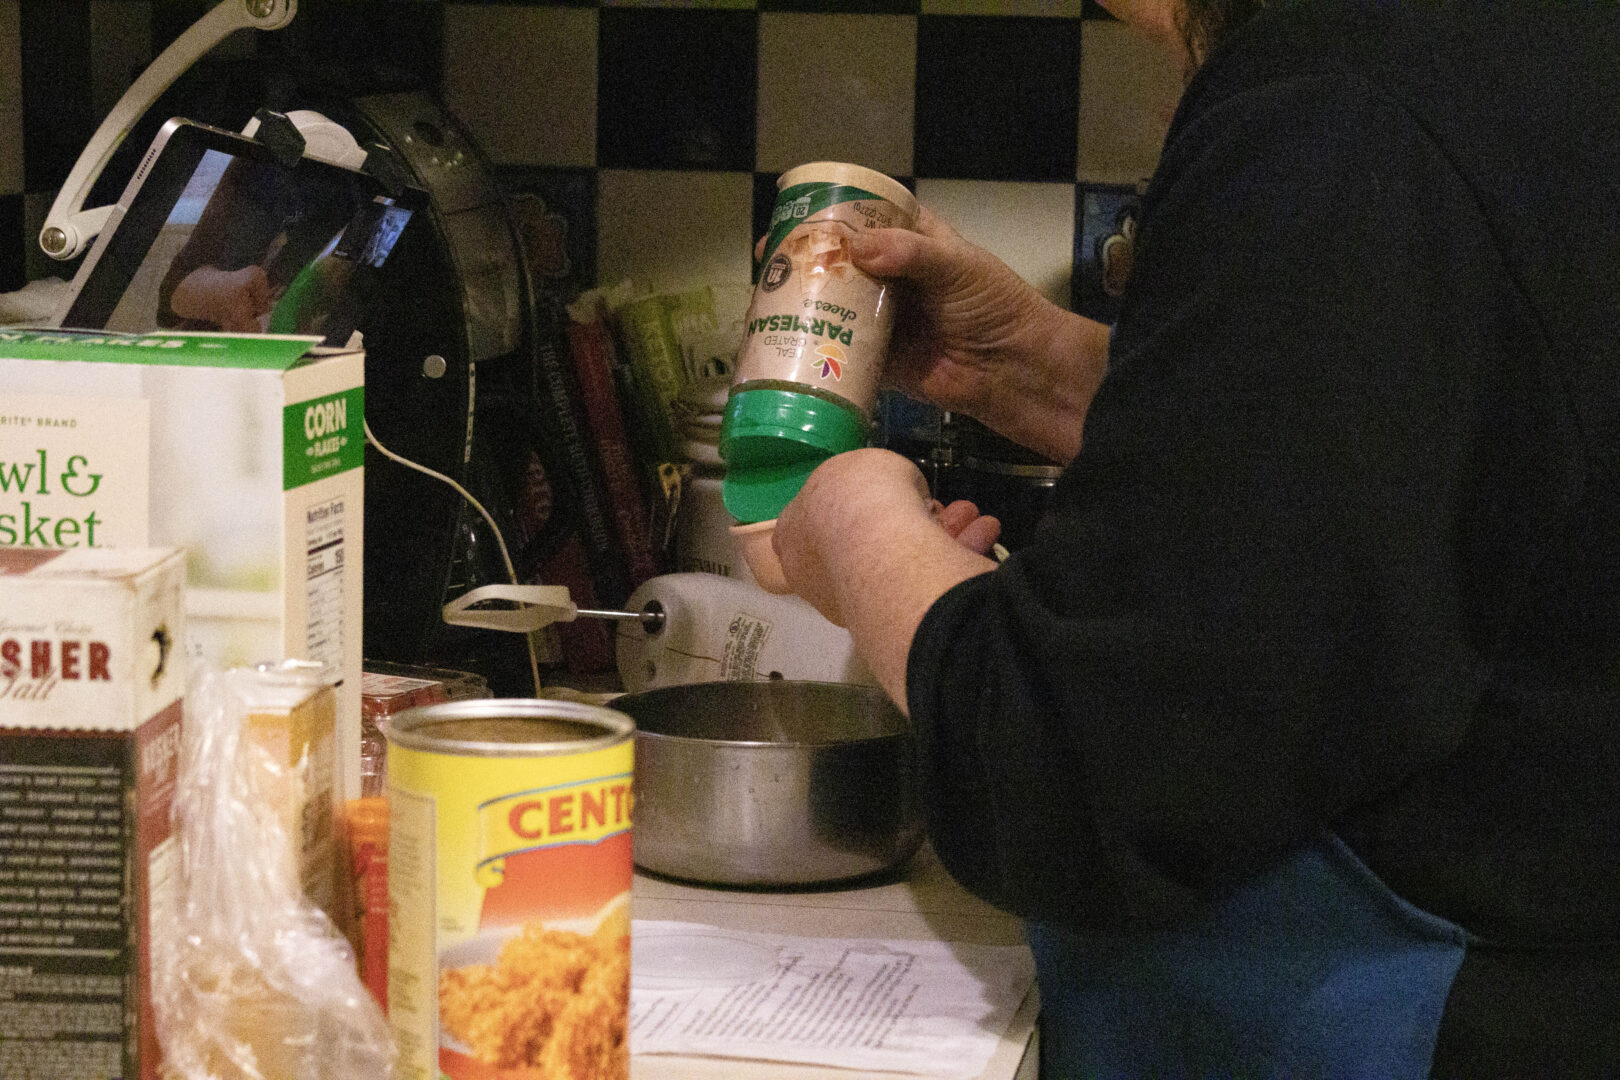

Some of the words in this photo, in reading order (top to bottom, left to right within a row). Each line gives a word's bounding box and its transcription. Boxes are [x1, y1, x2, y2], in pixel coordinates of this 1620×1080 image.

[749, 314, 854, 347] PARMESAN
[803, 299, 857, 322] cheese
[37, 417, 78, 428] BRAND
[304, 397, 347, 441] CORN
[60, 454, 103, 498] &
[0, 639, 112, 682] SHER
[508, 785, 634, 840] CENT
